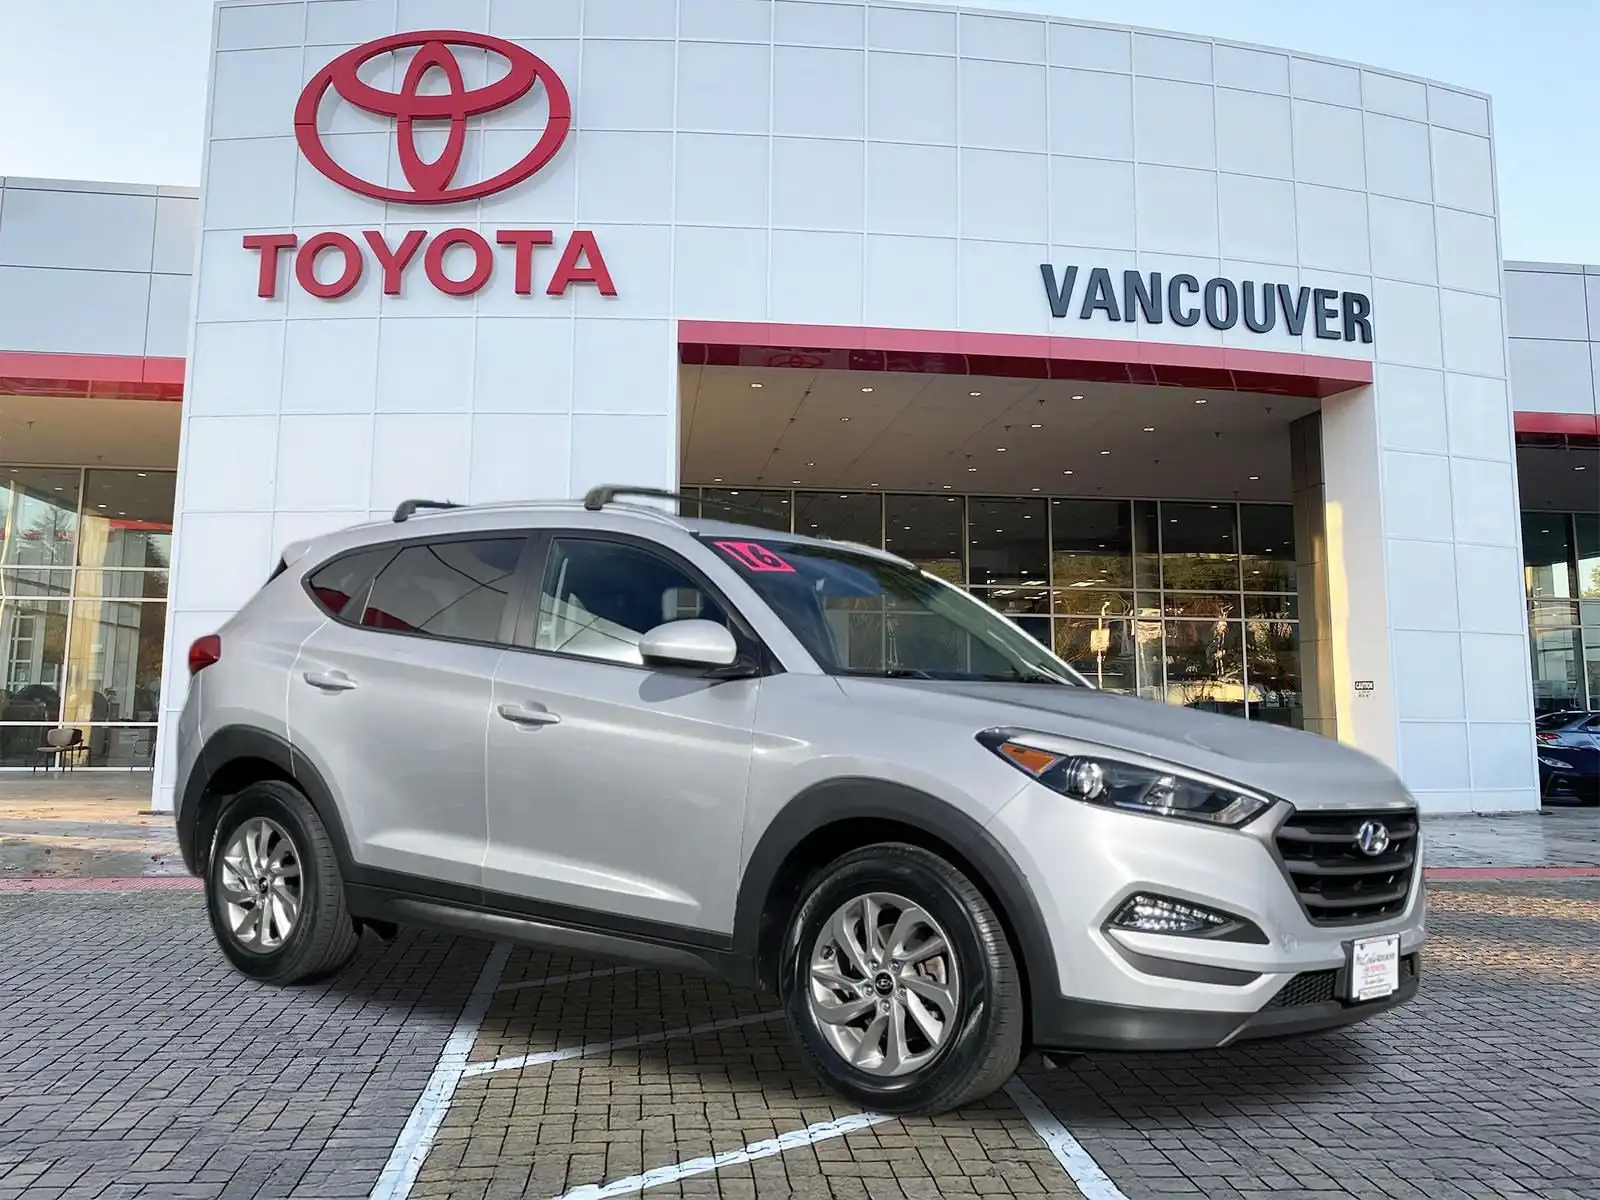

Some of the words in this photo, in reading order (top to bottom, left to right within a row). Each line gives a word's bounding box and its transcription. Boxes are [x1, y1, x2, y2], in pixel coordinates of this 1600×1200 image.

[243, 228, 618, 298] TOYOTA
[1040, 264, 1373, 343] VANCOUVER
[721, 543, 783, 568] 16
